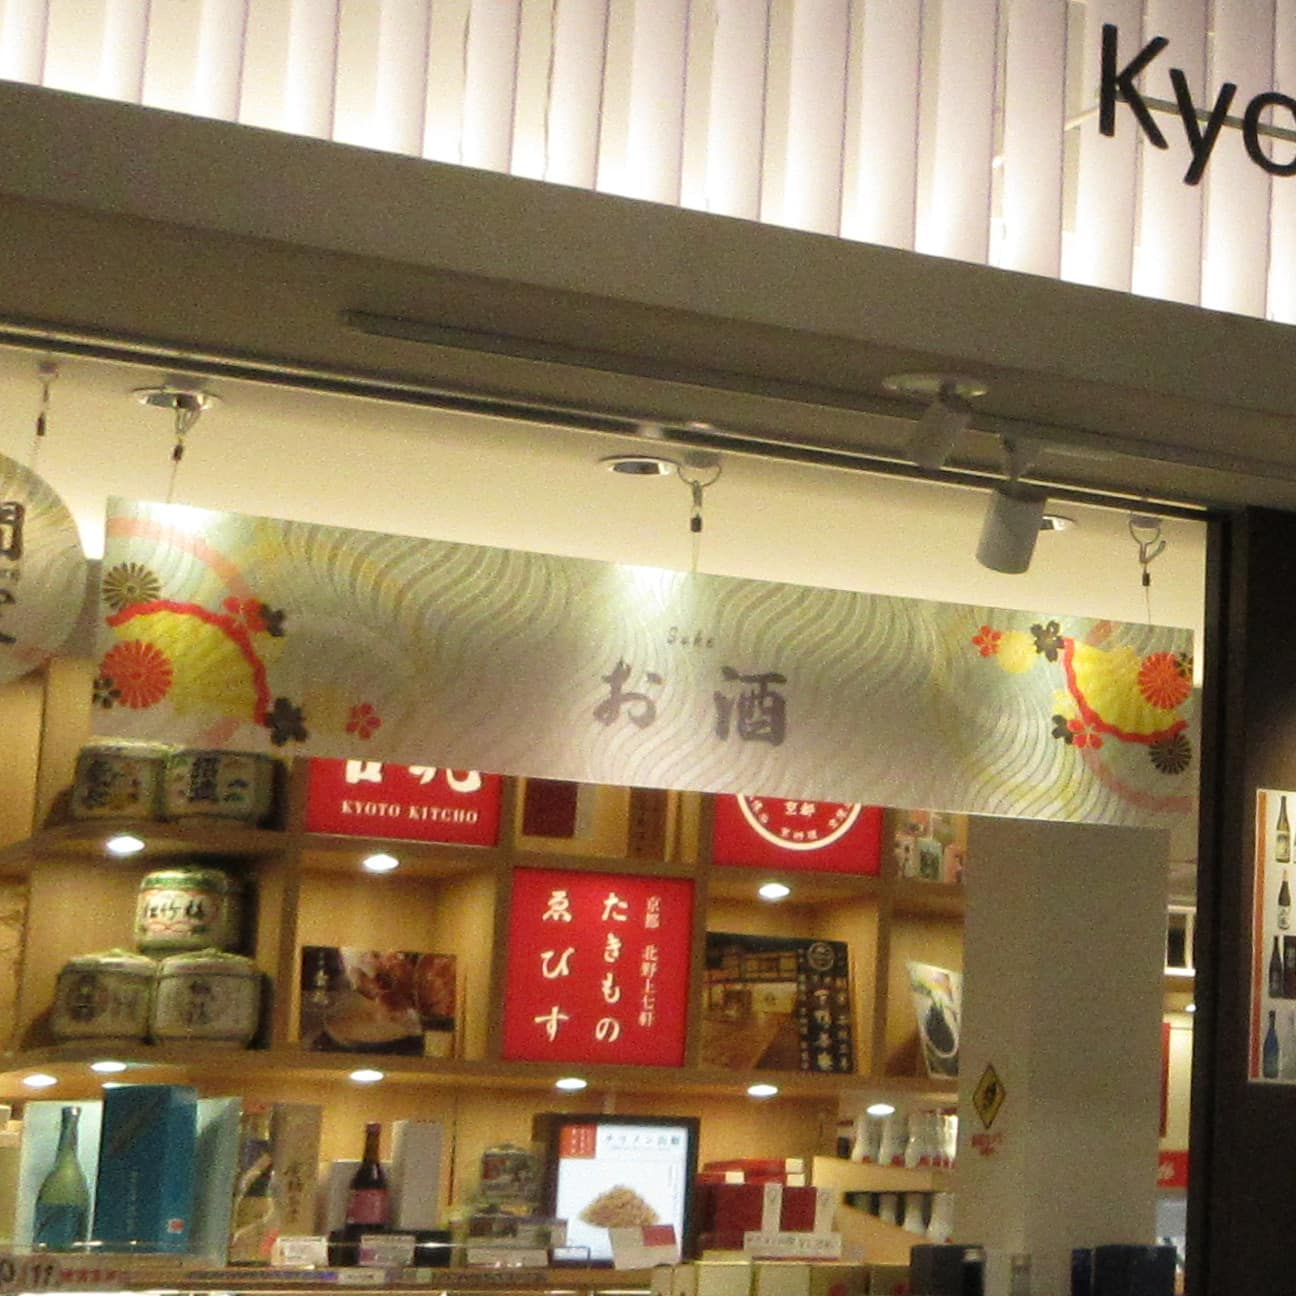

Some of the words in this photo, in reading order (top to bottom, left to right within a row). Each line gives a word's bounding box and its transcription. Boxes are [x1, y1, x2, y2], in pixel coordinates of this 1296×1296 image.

[593, 658, 788, 747] お酒
[341, 799, 400, 817] KYOTO
[408, 804, 478, 824] KITCHO
[595, 892, 630, 1044] たきもの
